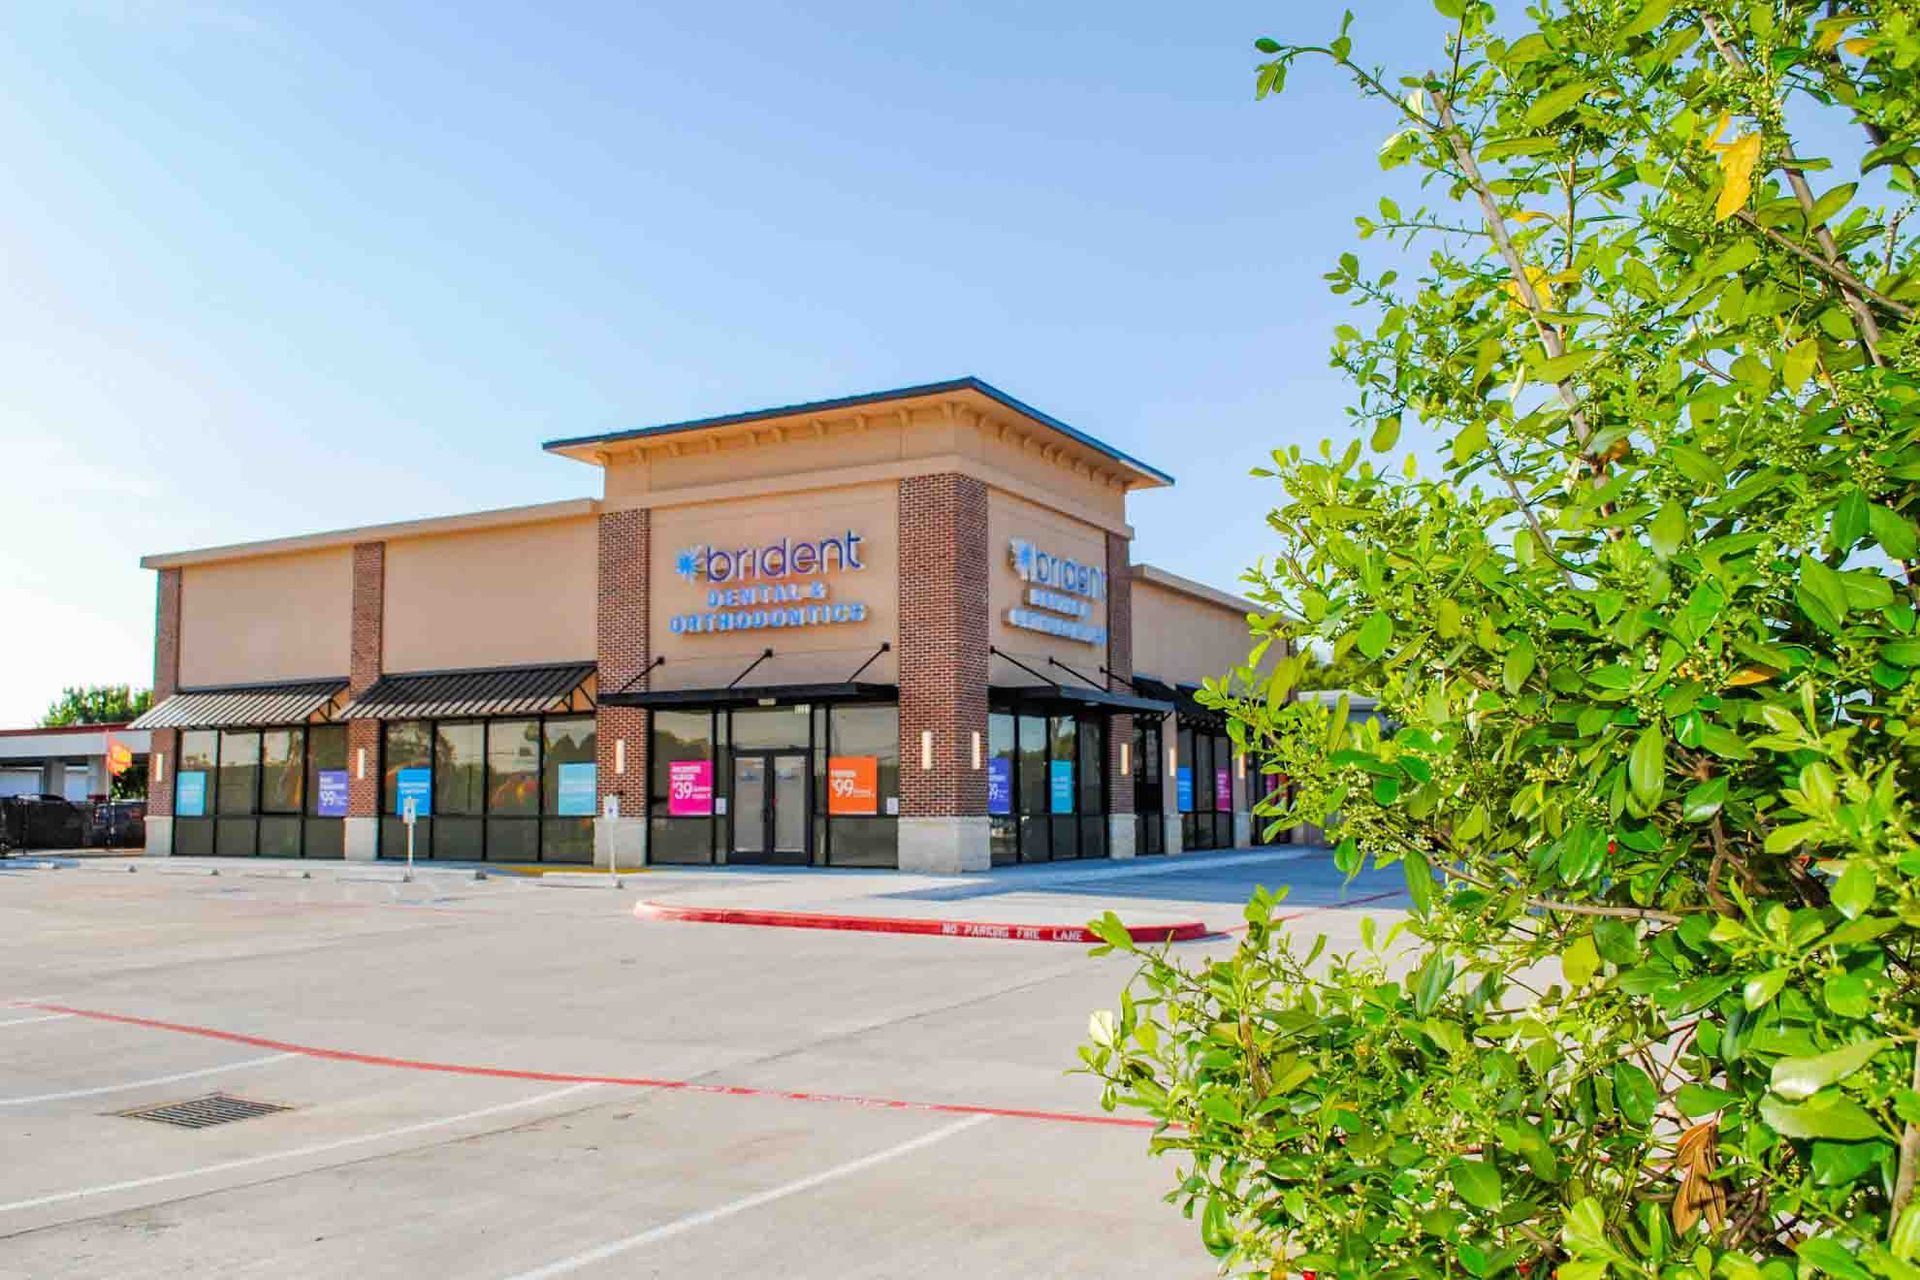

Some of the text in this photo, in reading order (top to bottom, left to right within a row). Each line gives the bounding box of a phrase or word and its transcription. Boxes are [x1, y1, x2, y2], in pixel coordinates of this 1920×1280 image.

[706, 530, 863, 582] brident
[708, 580, 826, 607] DENTAL &
[669, 602, 866, 634] ORTHODONTICS
[942, 922, 1083, 941] NO PARKING FIRE LANE
